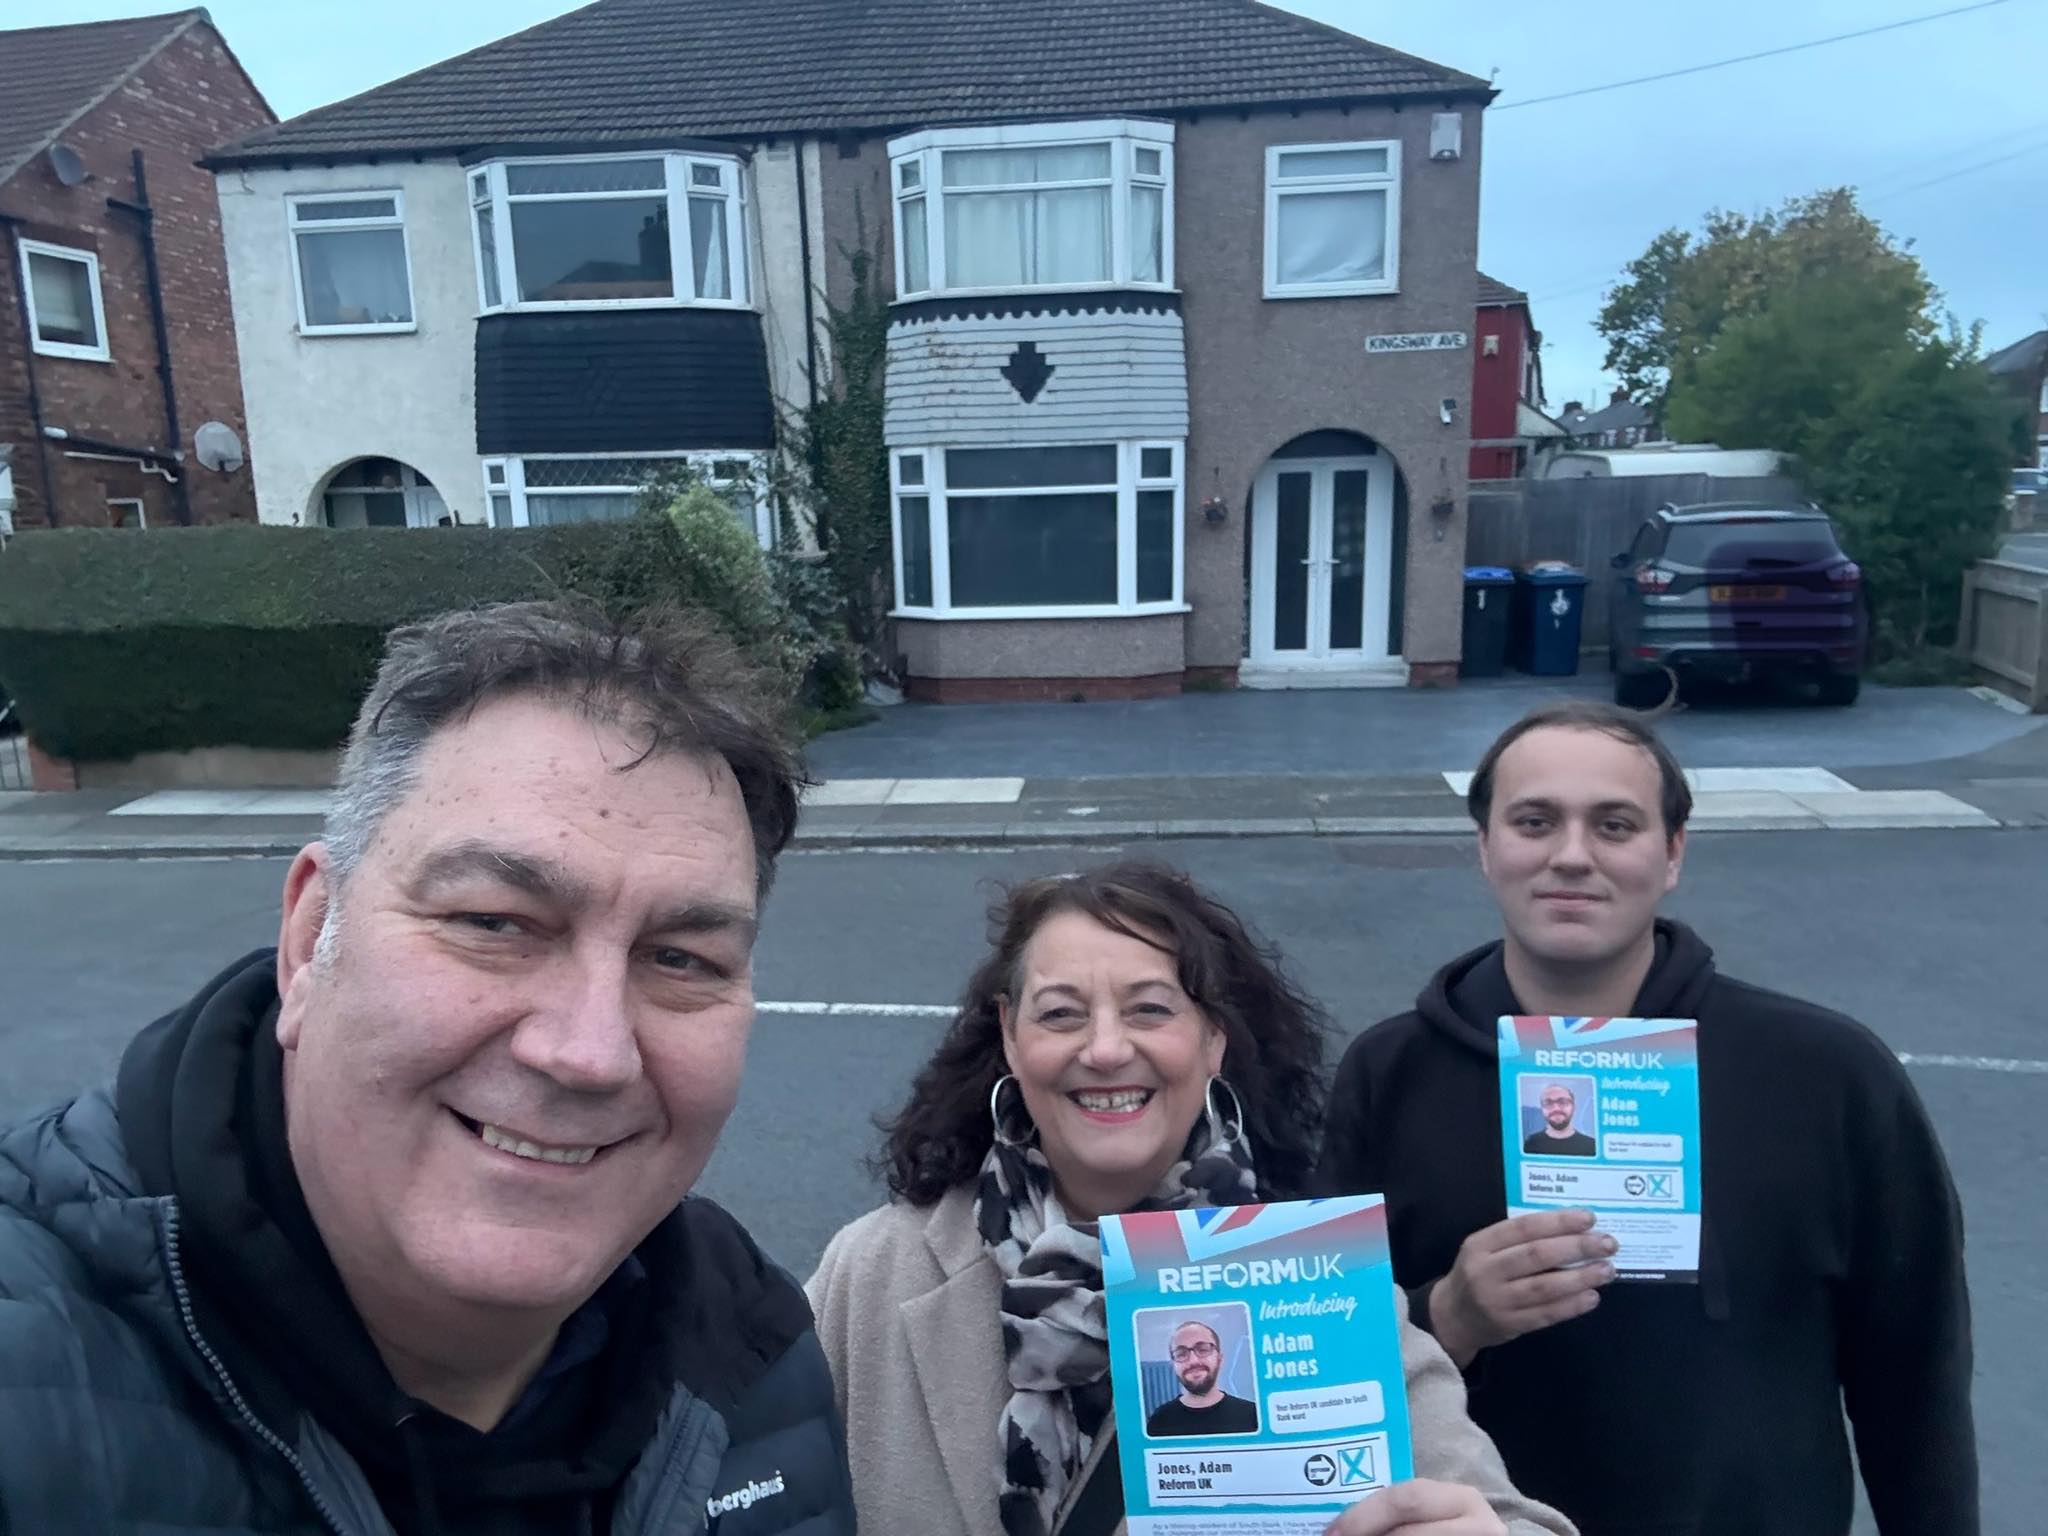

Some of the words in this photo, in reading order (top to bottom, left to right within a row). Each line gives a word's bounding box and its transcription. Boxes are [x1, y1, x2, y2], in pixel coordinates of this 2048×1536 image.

[1368, 335, 1434, 350] KINGSWAY
[1439, 334, 1463, 347] AVE
[1602, 1096, 1638, 1111] Adam
[1602, 1112, 1640, 1127] Jones
[1258, 1292, 1358, 1321] Introducing
[1262, 1333, 1314, 1355] Adam
[1264, 1358, 1319, 1379] Jones
[1157, 1463, 1196, 1475] Jones,
[1199, 1461, 1233, 1473] Adam
[1158, 1479, 1197, 1490] Reform
[1197, 1478, 1213, 1489] UK
[706, 1470, 785, 1517] berghaus
